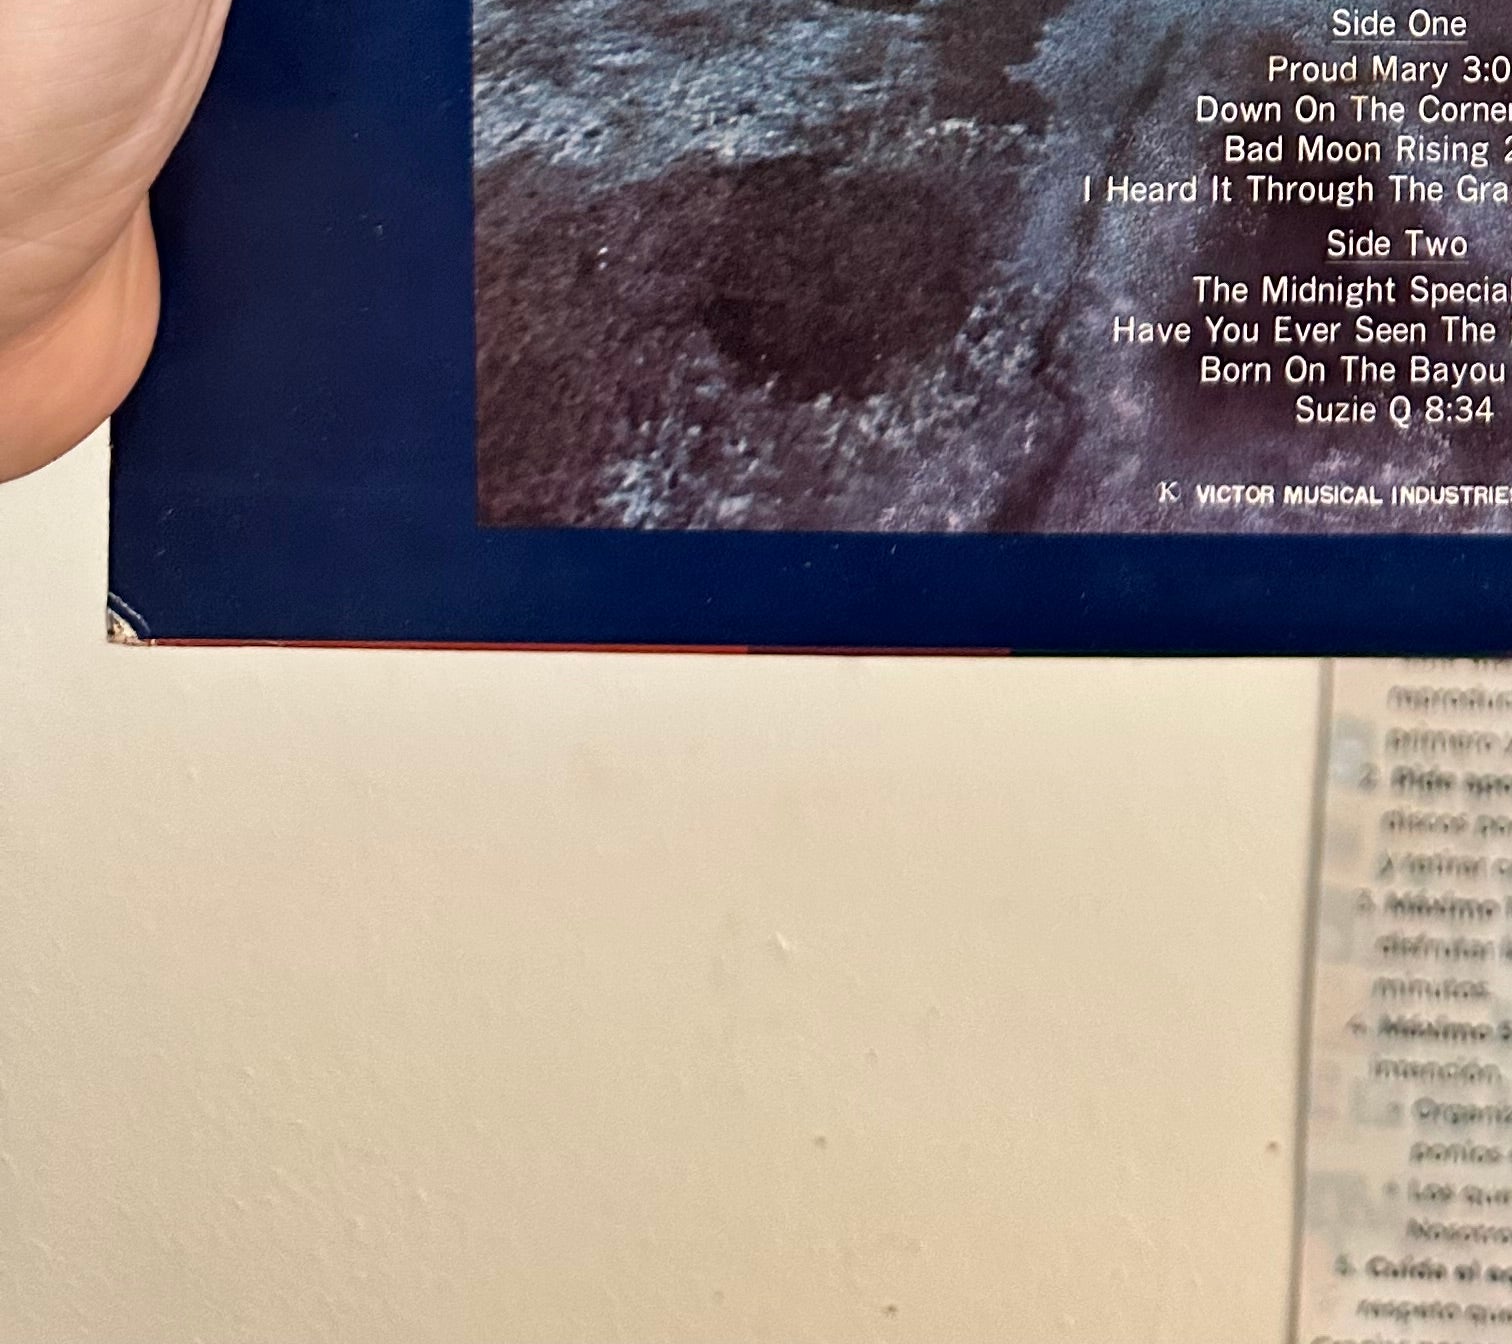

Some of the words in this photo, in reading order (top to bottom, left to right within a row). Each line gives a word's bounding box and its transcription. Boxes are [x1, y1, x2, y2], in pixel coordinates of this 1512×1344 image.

[1332, 8, 1396, 37] Side
[1408, 8, 1467, 38] One
[1268, 55, 1357, 83] Proud
[1372, 55, 1449, 87] Mary
[1196, 95, 1281, 123] Down
[1295, 94, 1335, 123] On
[1350, 95, 1405, 123] The
[1225, 134, 1283, 163] Bad
[1298, 134, 1381, 163] Moon
[1397, 135, 1489, 168] Rising
[1084, 175, 1091, 202] I
[1107, 175, 1197, 203] Heard
[1212, 175, 1232, 203] It
[1246, 174, 1374, 208] Through
[1388, 174, 1443, 203] The
[1327, 228, 1391, 257] Side
[1404, 229, 1468, 257] Two
[1192, 275, 1249, 304] The
[1262, 275, 1396, 309] Midnight
[1113, 316, 1191, 344] Have
[1205, 315, 1259, 343] You
[1274, 315, 1342, 343] Ever
[1355, 315, 1426, 344] Seen
[1440, 315, 1496, 343] The
[1201, 355, 1271, 383] Born
[1284, 354, 1325, 384] On
[1340, 355, 1396, 383] The
[1410, 355, 1505, 388] Bayou
[1296, 395, 1377, 424] Suzie
[1389, 395, 1411, 429] Q
[1425, 395, 1495, 424] 8:34
[1195, 484, 1275, 507] VICTOR
[1283, 484, 1384, 507] MUSICAL
